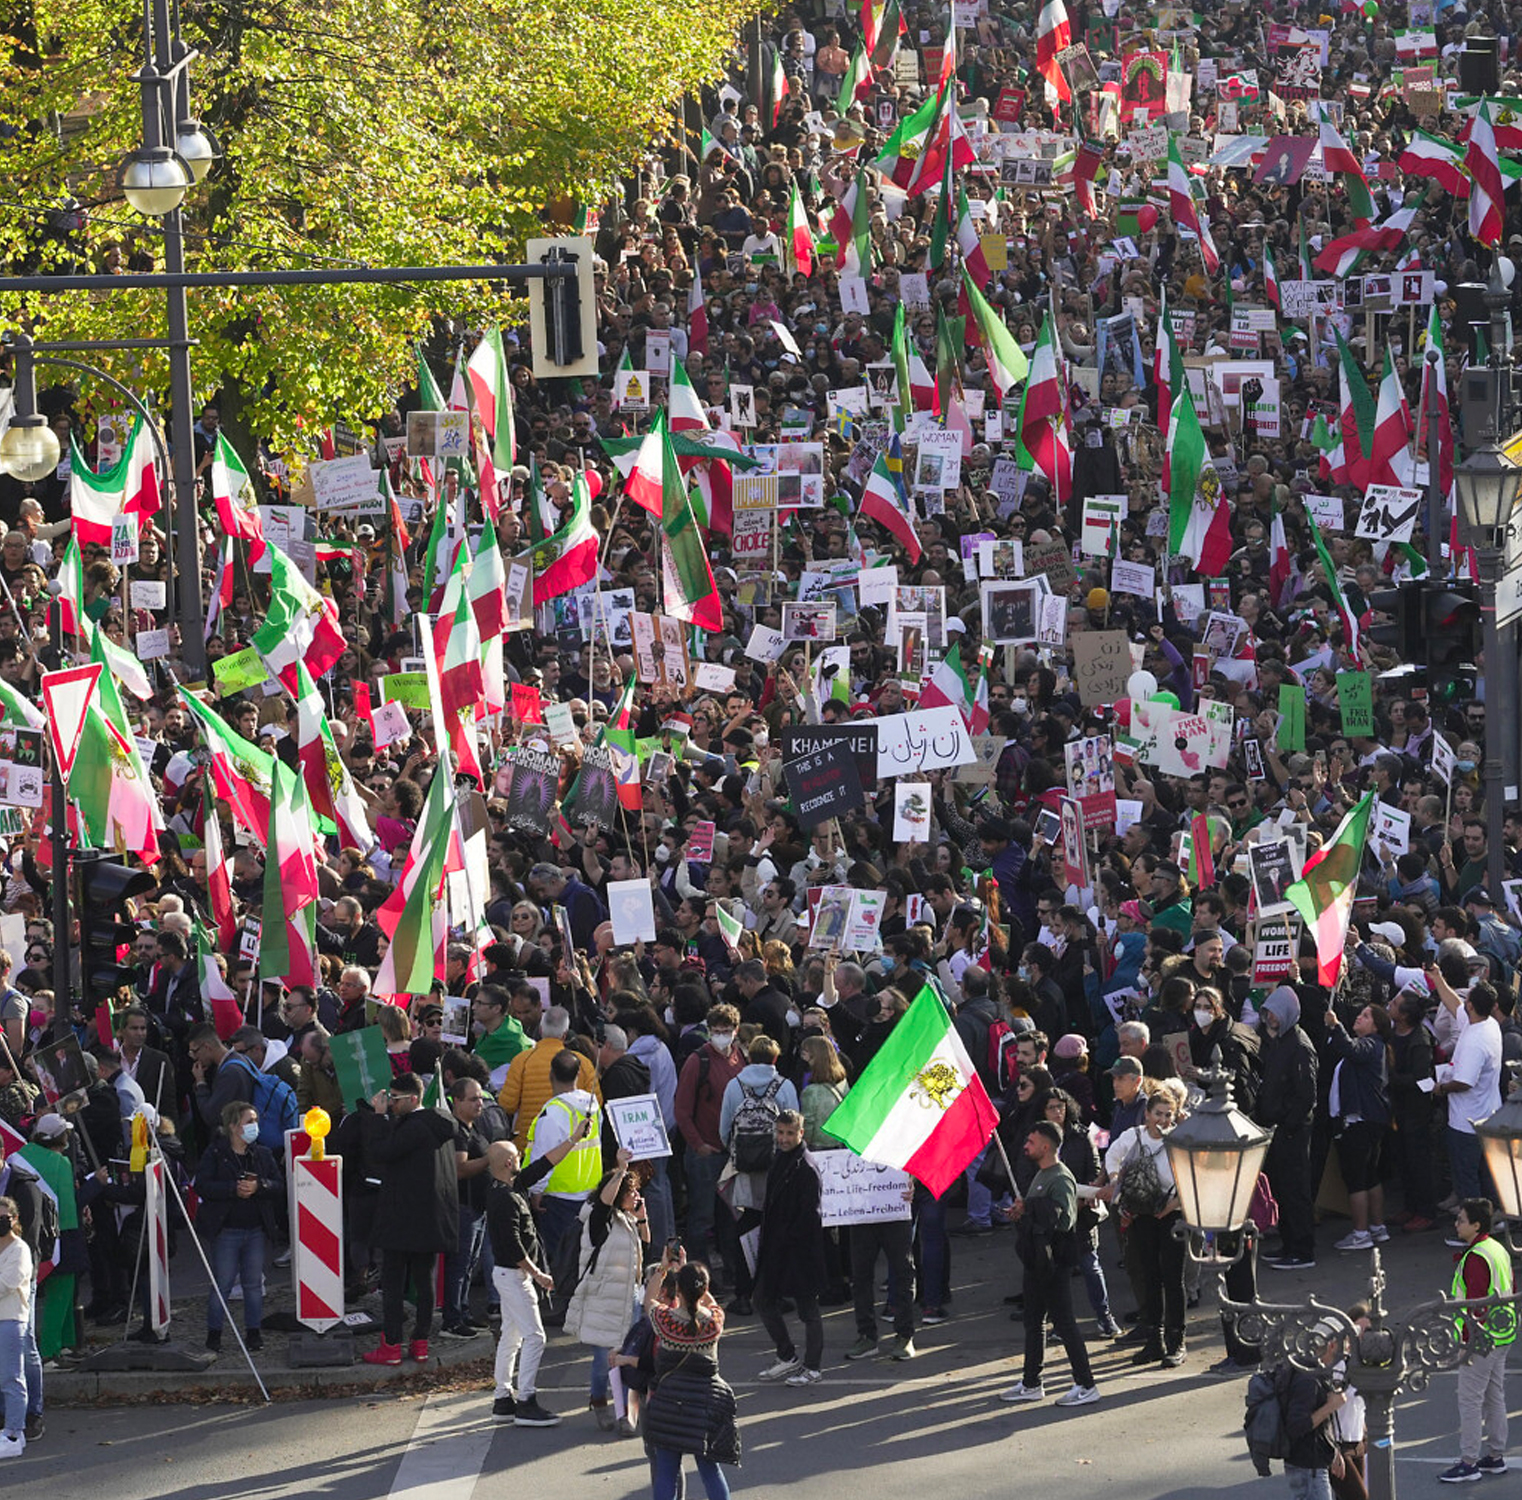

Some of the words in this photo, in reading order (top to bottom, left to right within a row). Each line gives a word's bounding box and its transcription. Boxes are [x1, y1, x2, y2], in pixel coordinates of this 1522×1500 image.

[1246, 402, 1276, 412] FRAUEN
[922, 433, 958, 444] WOMAN
[360, 500, 382, 509] IRAN
[743, 517, 764, 526] about
[114, 523, 136, 541] ZAN
[735, 525, 759, 534] having
[733, 532, 770, 553] CHOICE
[1031, 553, 1065, 568] KEINE
[768, 635, 784, 646] Life
[1100, 641, 1120, 655] زن
[1350, 708, 1369, 717] FREE
[1177, 716, 1205, 730] FREE
[1346, 716, 1369, 727] IRAN
[1174, 724, 1208, 742] IRAN
[516, 747, 561, 770] WOMAN
[583, 744, 611, 763] WOM
[515, 757, 529, 768] LIFE
[795, 759, 812, 776] THIS
[814, 756, 823, 767] IS
[827, 752, 834, 761] A
[799, 792, 836, 815] RECOGNIZE
[838, 785, 847, 797] IT
[1265, 944, 1289, 957] LIFE
[1256, 963, 1290, 973] FREEDO
